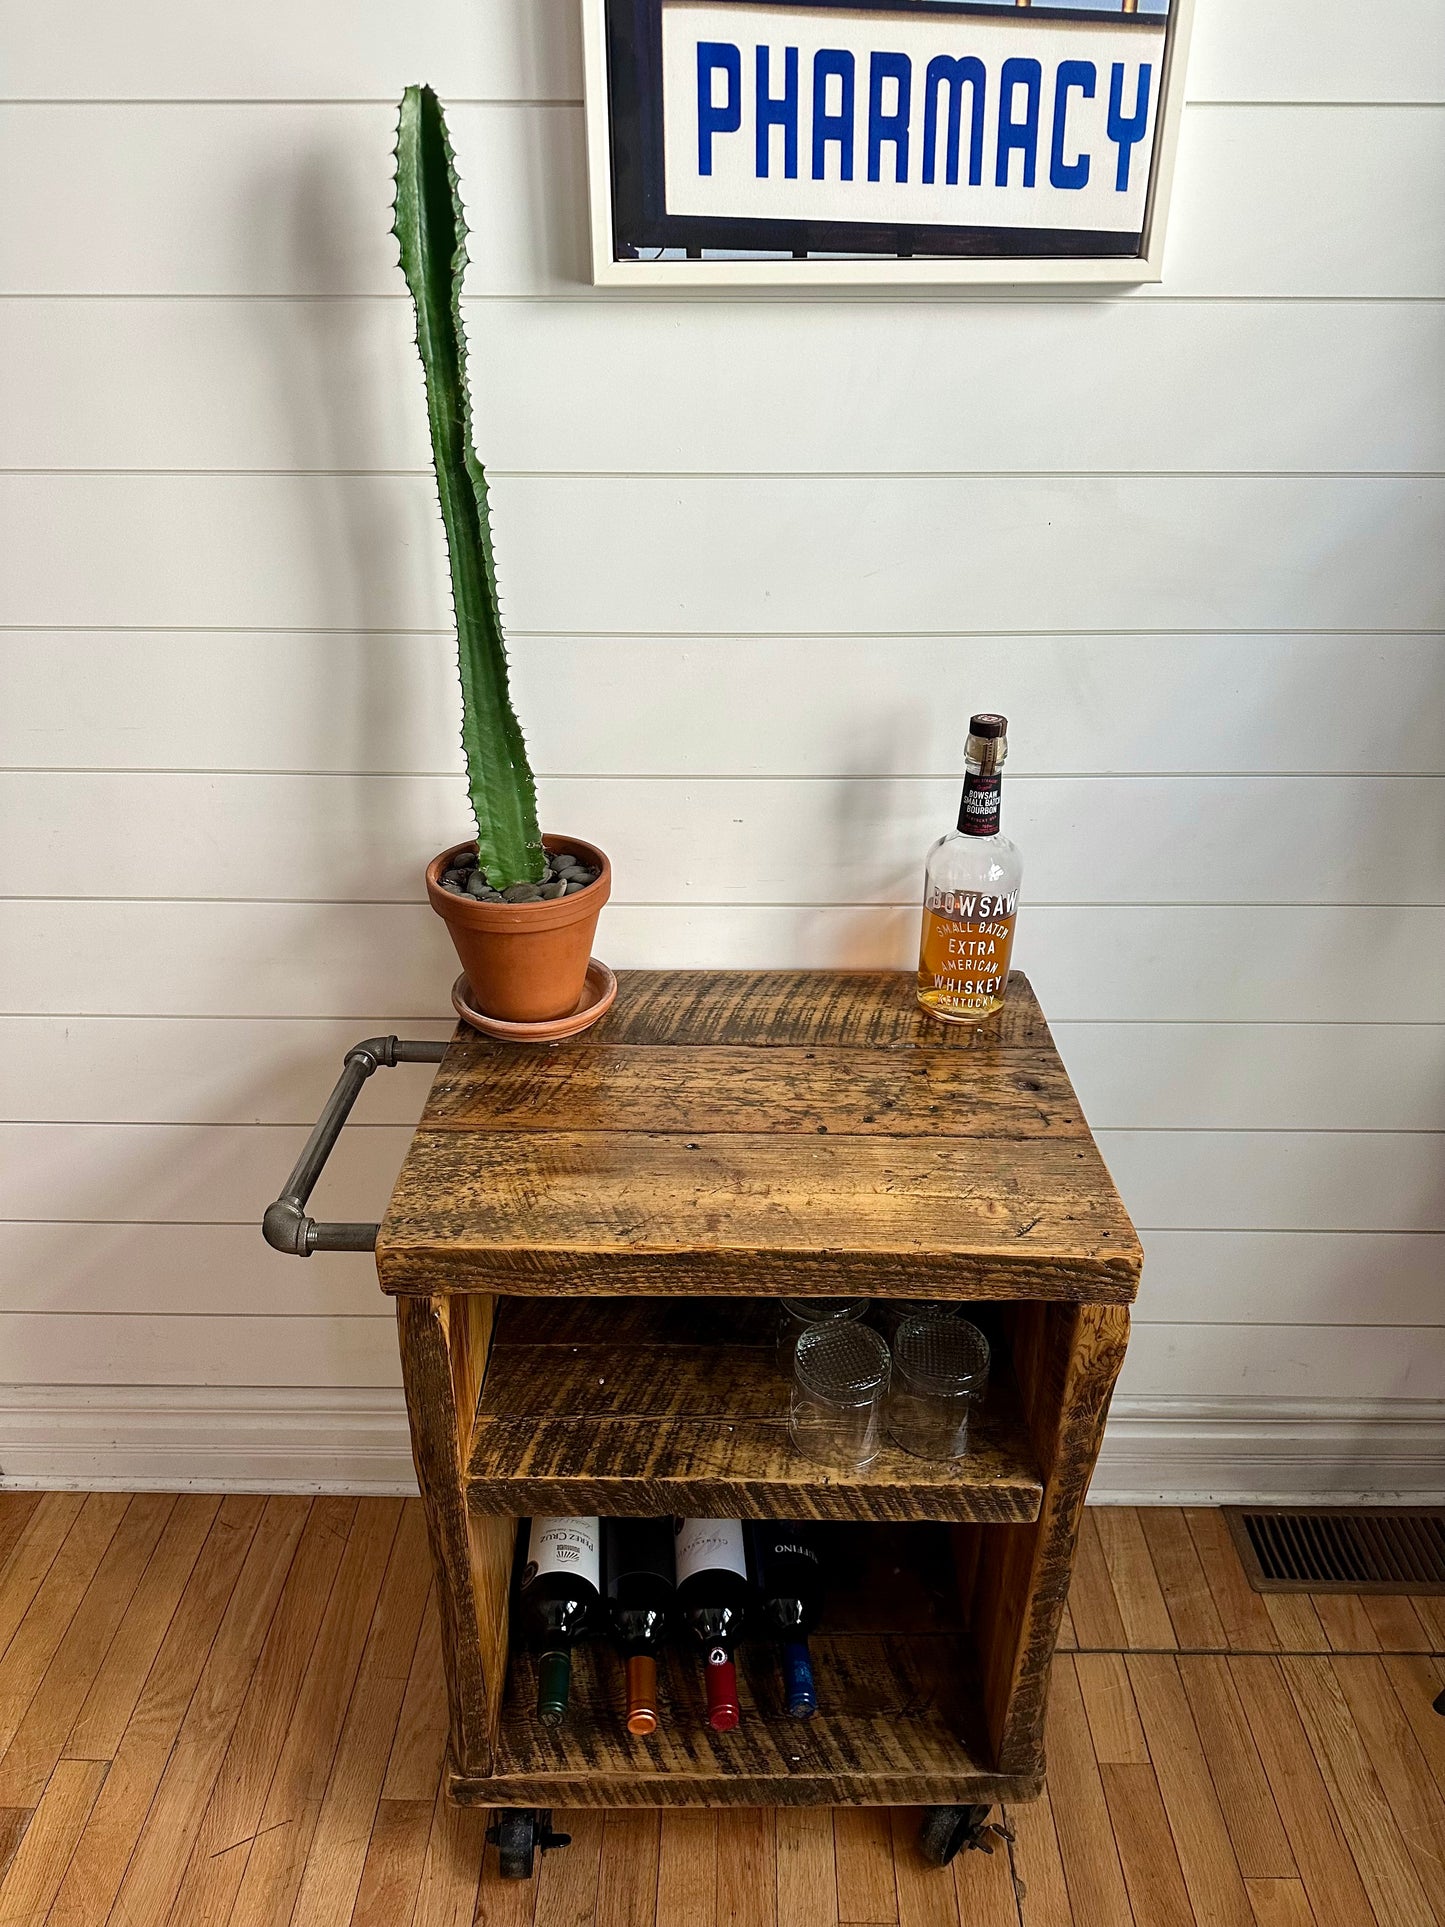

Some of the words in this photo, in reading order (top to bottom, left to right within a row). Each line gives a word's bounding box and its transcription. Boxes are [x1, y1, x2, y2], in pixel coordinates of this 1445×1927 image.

[697, 41, 1152, 192] PHARMACY
[963, 796, 985, 807] SMALL
[969, 789, 998, 800] BOWSAW
[966, 805, 997, 815] BOURBON
[932, 887, 1019, 918] BOWSAW
[936, 921, 973, 938] SMALL
[978, 921, 1009, 940] BATCH
[949, 938, 995, 956] EXTRA
[941, 959, 999, 974] AMERICAN
[934, 973, 1002, 995] WHISKEY
[938, 993, 995, 1008] KENTUCKY
[540, 1532, 567, 1544] CRUZ
[569, 1532, 594, 1552] PEREZ
